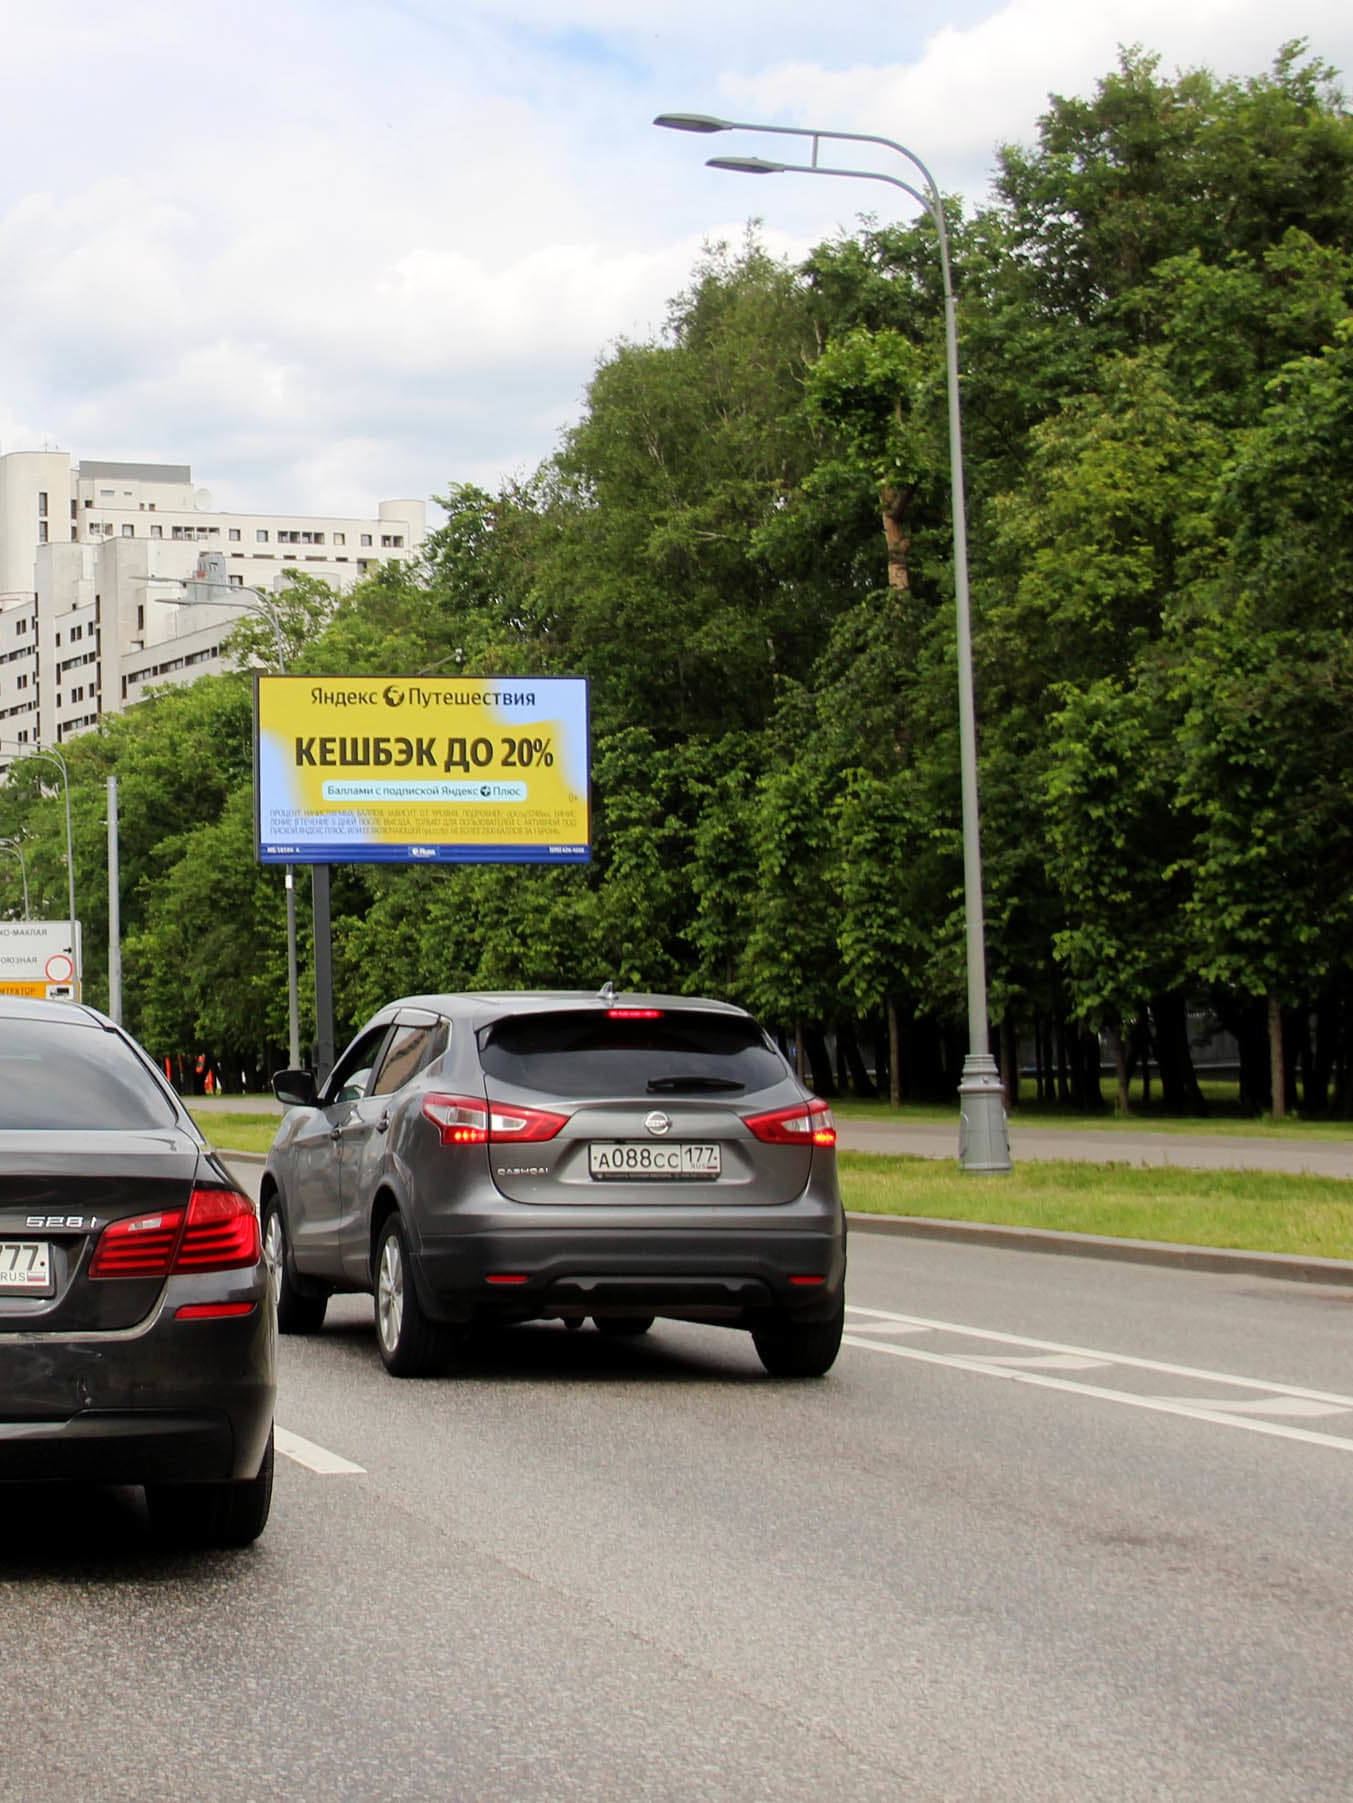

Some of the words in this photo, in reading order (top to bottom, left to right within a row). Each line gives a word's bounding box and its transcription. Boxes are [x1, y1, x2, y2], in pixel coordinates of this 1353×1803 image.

[311, 687, 378, 707] Яндекс
[408, 687, 536, 709] Путешествия
[295, 736, 437, 767] КЕШБЭК
[444, 737, 494, 772] ДО
[501, 737, 554, 767] 20%
[327, 785, 373, 796] Баллами
[383, 785, 439, 798] подпиской
[440, 786, 479, 798] Яндекс
[493, 786, 521, 797] Плюс
[599, 1148, 679, 1169] А088СС
[685, 1147, 714, 1163] 177
[0, 1272, 26, 1282] RUS
